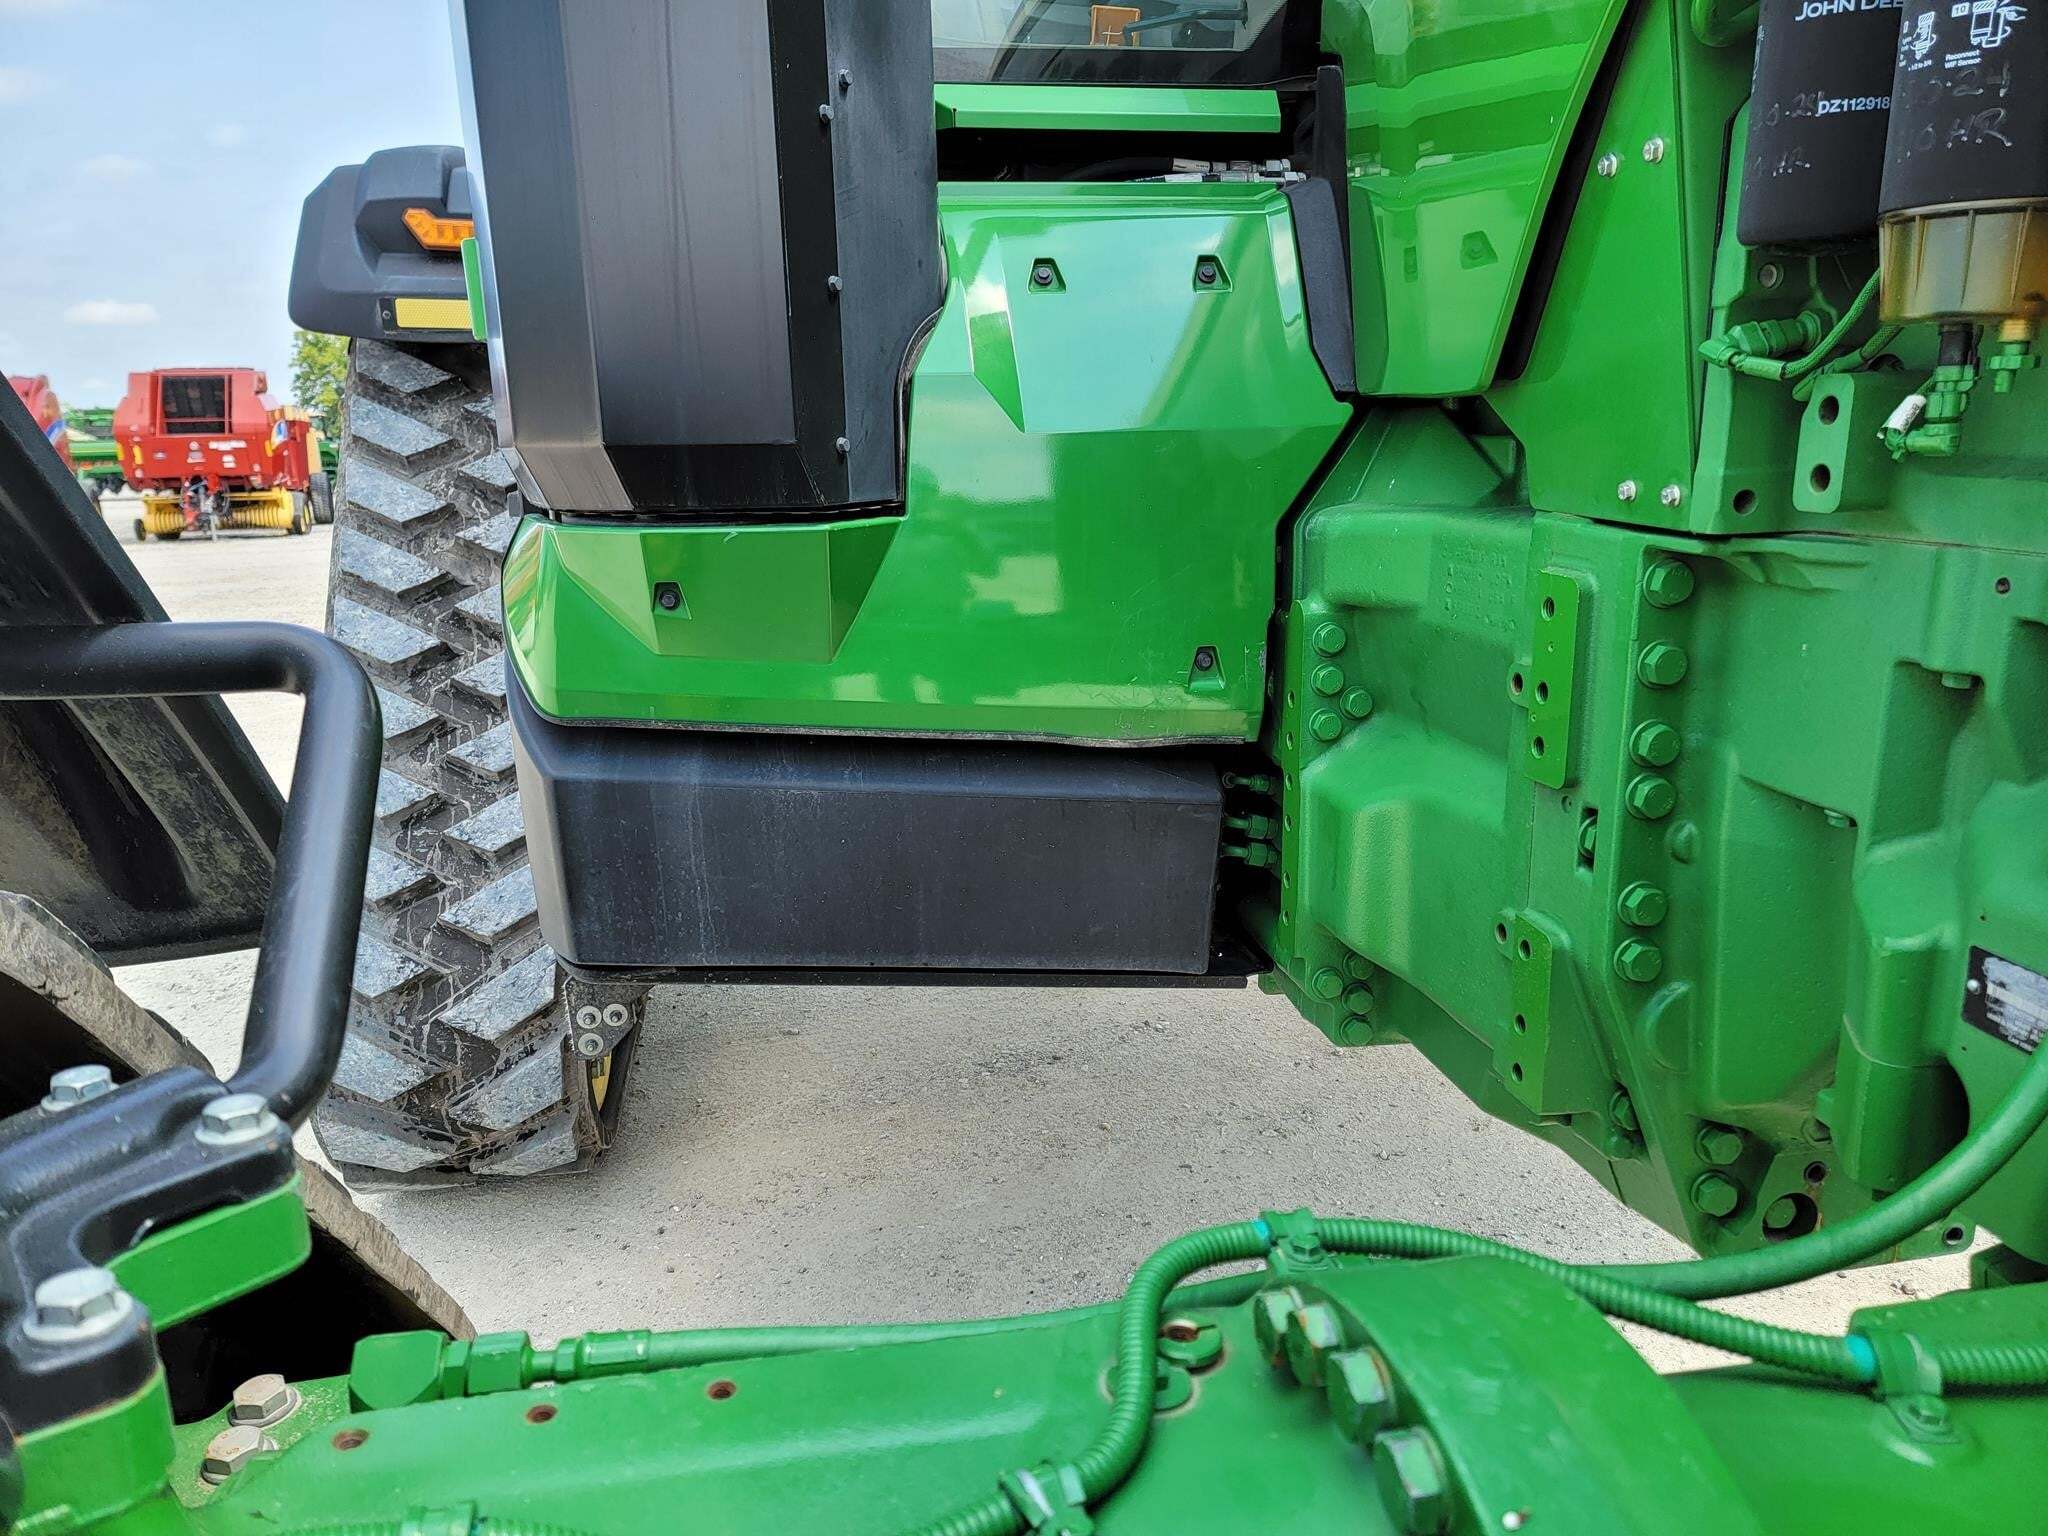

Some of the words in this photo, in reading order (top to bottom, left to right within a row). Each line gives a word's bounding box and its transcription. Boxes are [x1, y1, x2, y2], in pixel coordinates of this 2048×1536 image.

[1795, 0, 1856, 21] JOHN
[1945, 49, 1980, 60] Reconnect
[1958, 57, 1981, 66] Sensor
[1818, 96, 1890, 115] DZ112918
